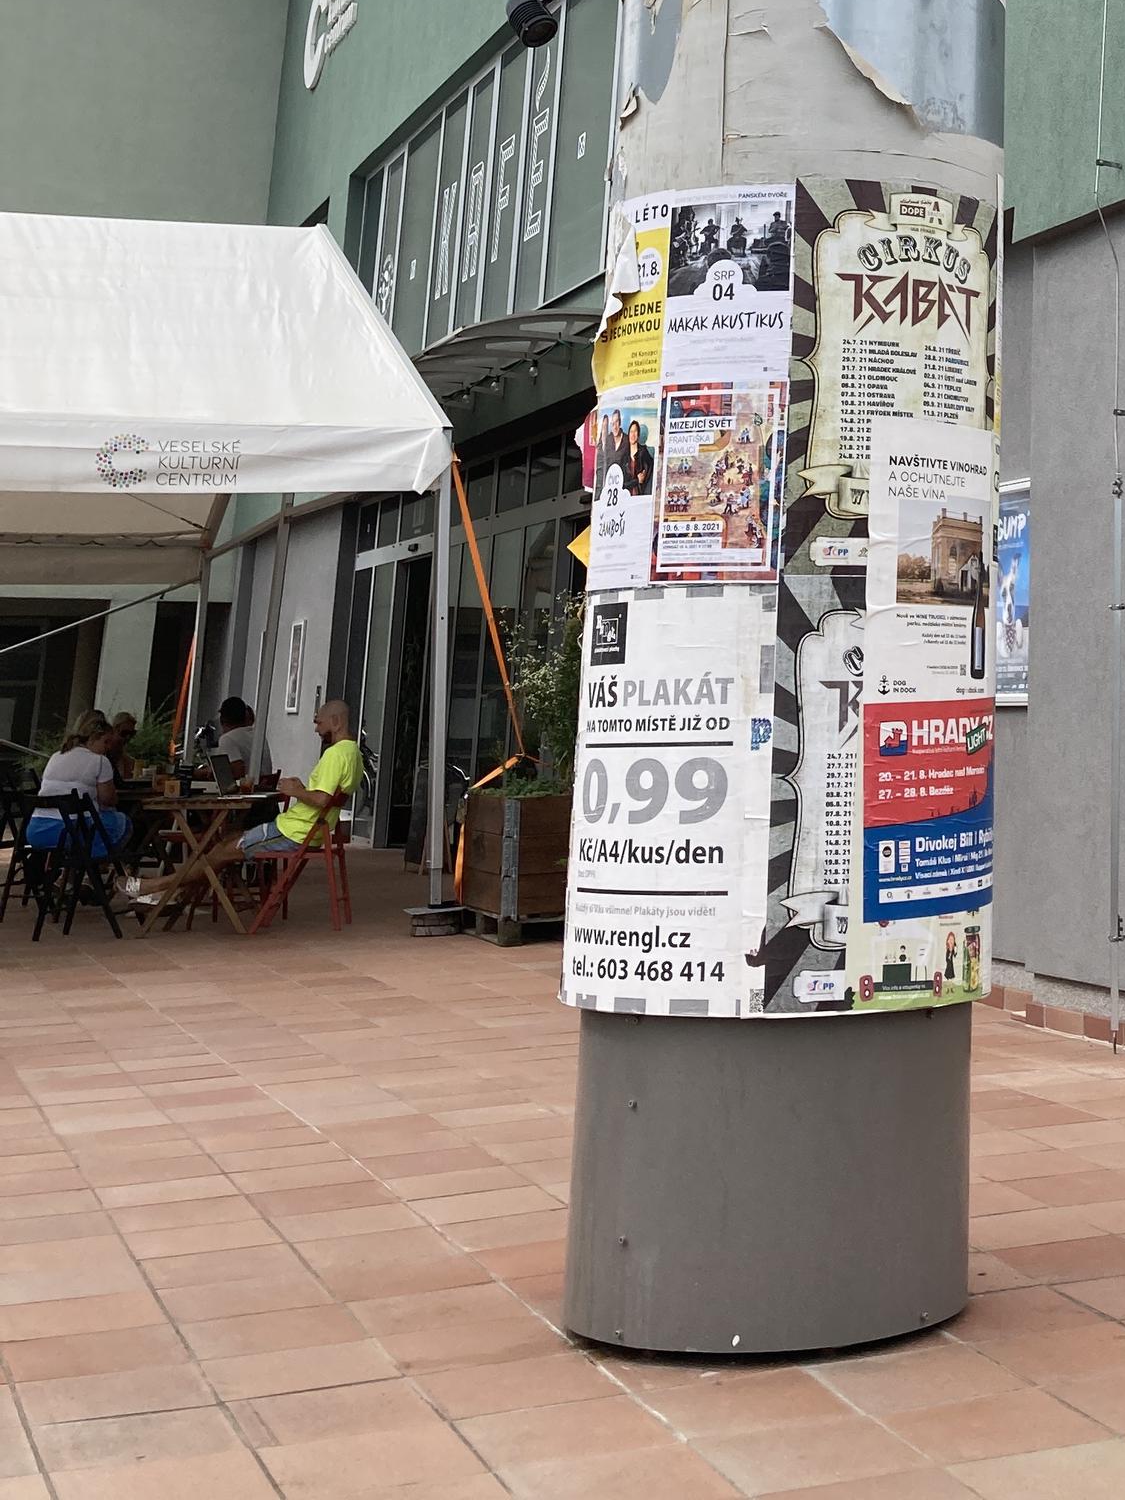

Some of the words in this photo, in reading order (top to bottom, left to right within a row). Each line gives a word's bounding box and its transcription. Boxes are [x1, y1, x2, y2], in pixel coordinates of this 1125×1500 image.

[635, 203, 669, 223] LÉTO
[901, 206, 924, 216] DOPE
[857, 234, 971, 284] CIRKUS
[713, 270, 735, 281] SRP
[712, 283, 735, 301] 04
[667, 316, 709, 333] MAKAK
[712, 311, 784, 330] AKUSTIKUS
[670, 419, 706, 430] MIZEJÍCÍ
[709, 418, 732, 428] SVĚT
[158, 440, 241, 453] VESELSKÉ
[158, 454, 241, 470] KULTURNÍ
[889, 454, 948, 471] NAVŠTIVTE
[950, 460, 988, 476] VINOHRAD
[156, 472, 237, 486] CENTRUM
[889, 471, 897, 481] A
[901, 471, 966, 488] OCHUTNEJTE
[607, 488, 618, 507] 28
[888, 486, 919, 499] NAŠE
[922, 486, 946, 500] VÍNA
[702, 523, 719, 531] 2021
[588, 674, 617, 708] VÁŠ
[623, 671, 734, 707] PLAKÁT
[586, 720, 597, 733] NA
[597, 718, 632, 733] TOMTO
[635, 715, 676, 732] MÍSTĚ
[679, 714, 702, 731] JIŽ
[706, 717, 731, 731] OD
[967, 728, 986, 751] LIGHT
[879, 772, 893, 782] 20.
[904, 770, 917, 780] 21.
[583, 756, 729, 825] 0,99
[879, 789, 893, 799] 27.
[916, 834, 957, 852] Divokej
[960, 831, 972, 847] Bill
[579, 838, 724, 865] Kč/A4/kus/den
[634, 906, 665, 918] Plakáty
[666, 907, 686, 918] jsou
[688, 906, 716, 916] vidět!
[574, 926, 691, 953] www.rengl.cz
[572, 955, 593, 977] tel.:
[597, 958, 628, 980] 603
[634, 961, 673, 981] 468
[680, 961, 725, 982] 414
